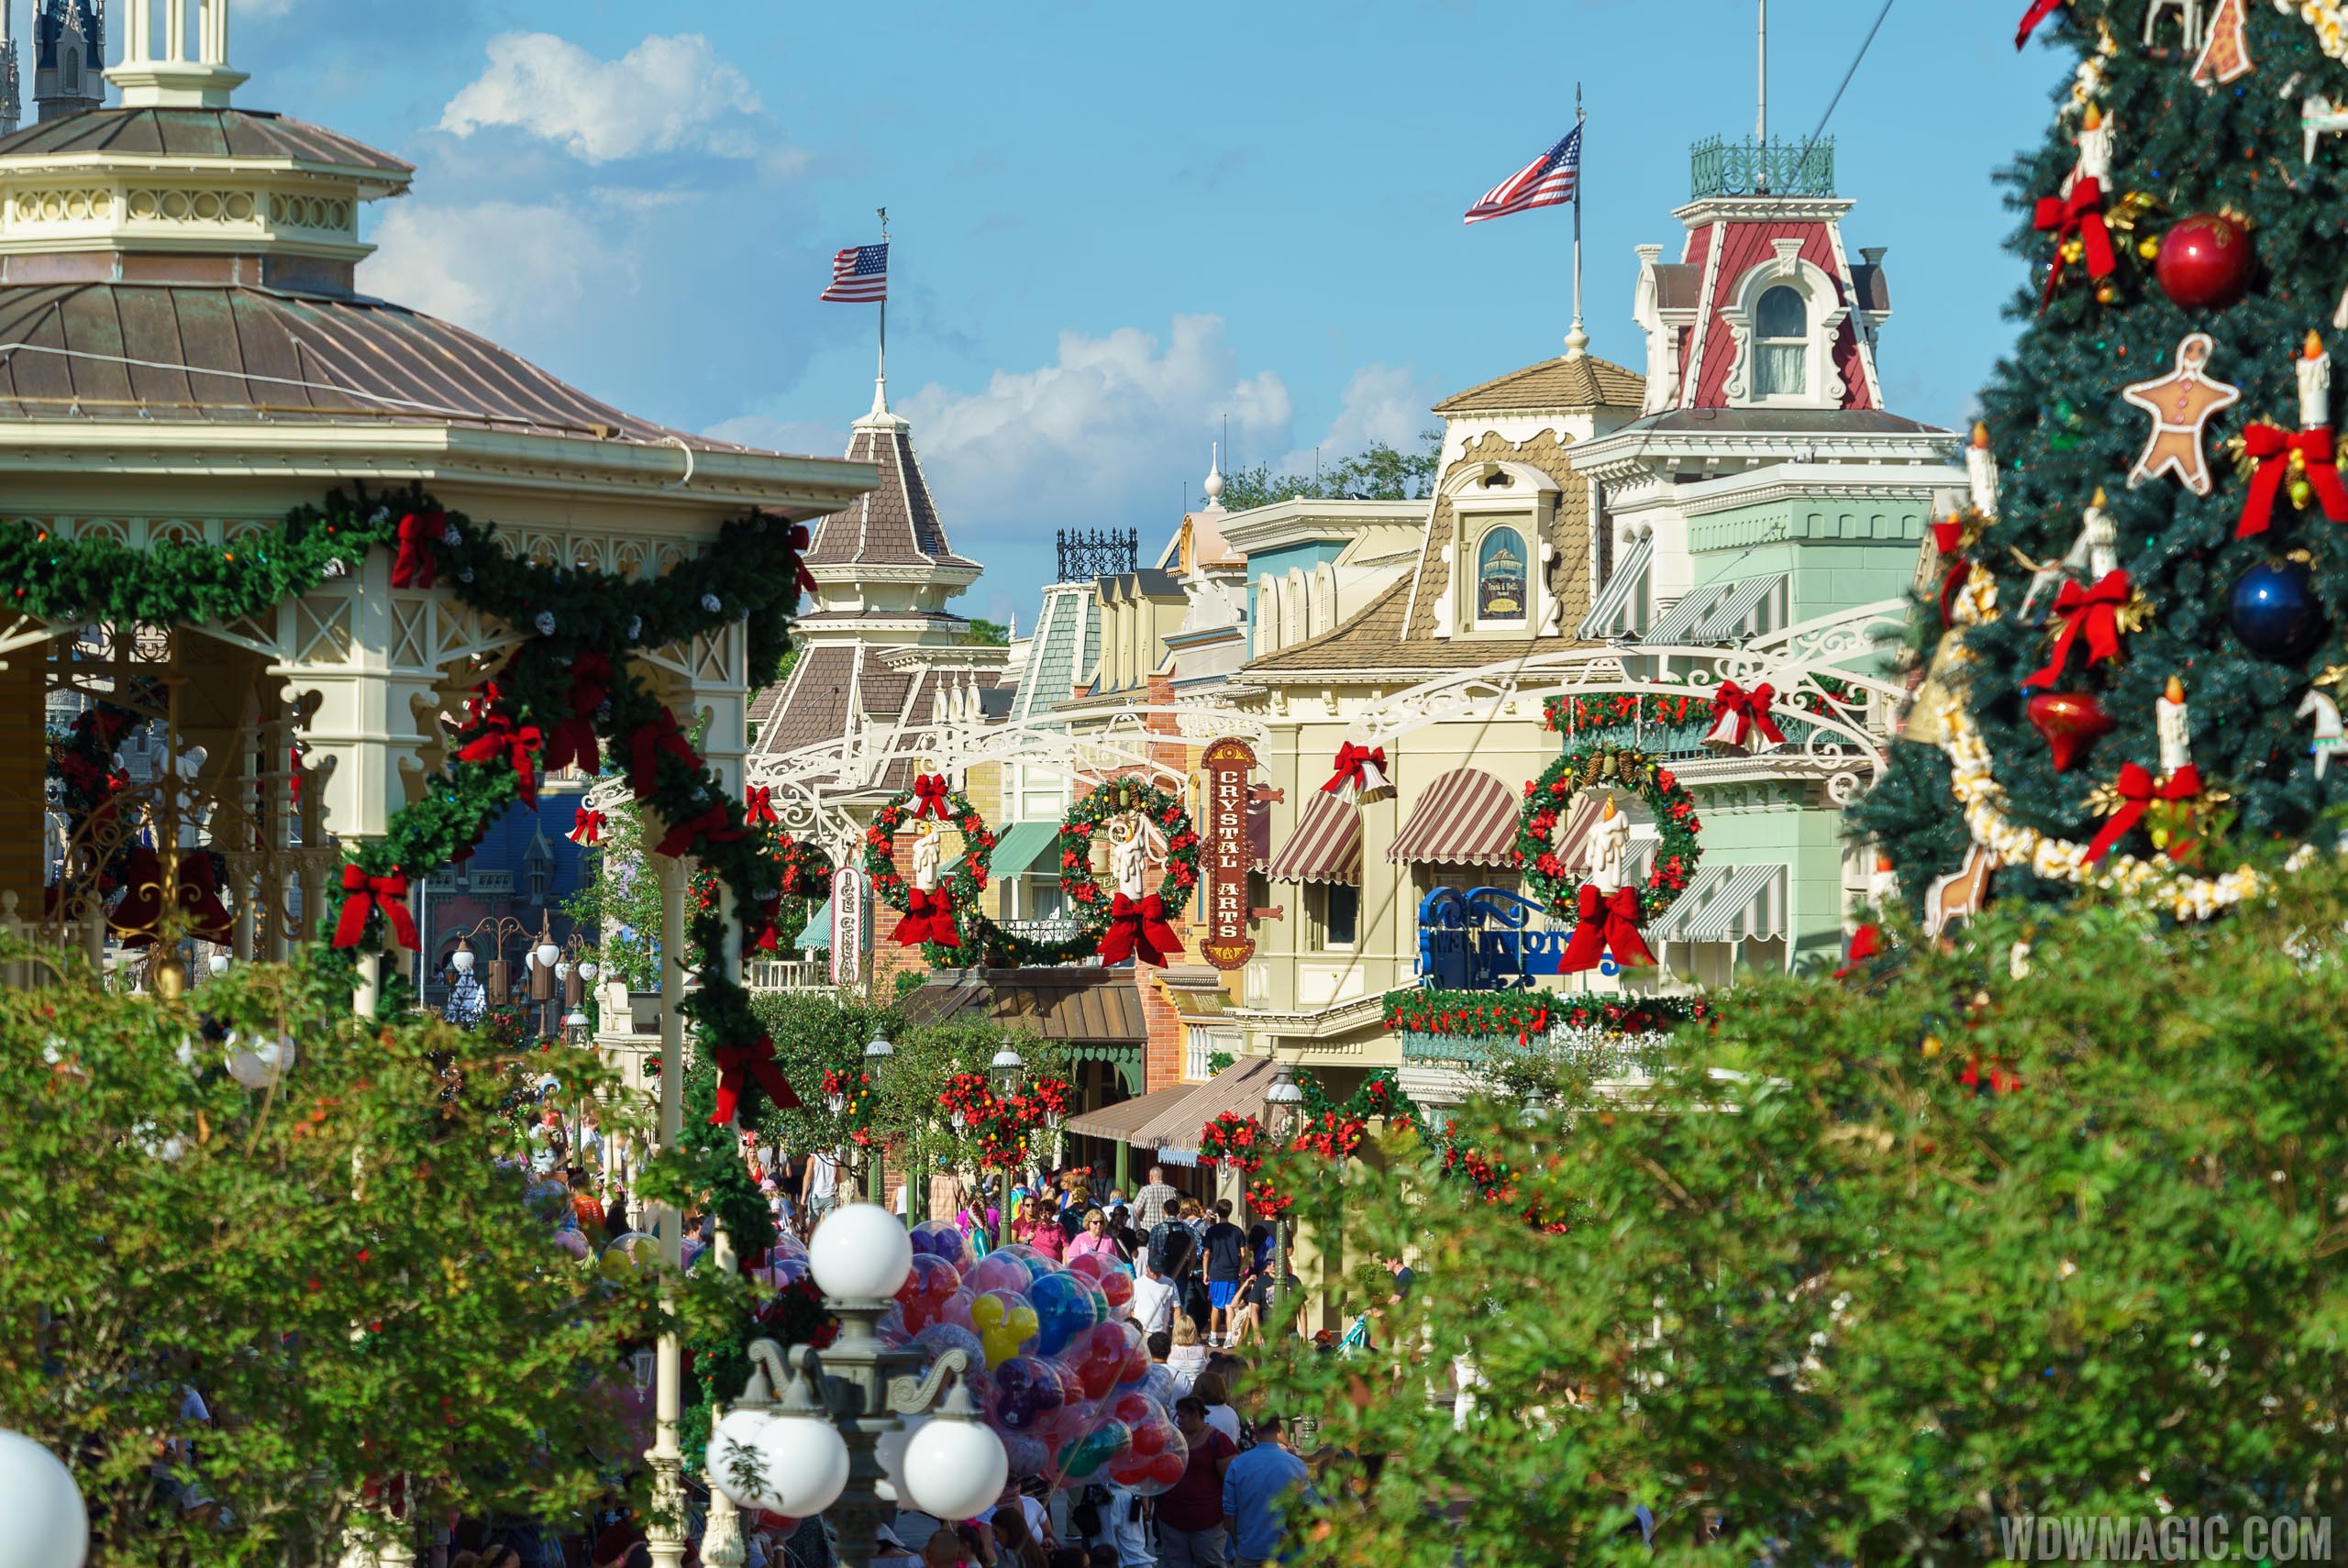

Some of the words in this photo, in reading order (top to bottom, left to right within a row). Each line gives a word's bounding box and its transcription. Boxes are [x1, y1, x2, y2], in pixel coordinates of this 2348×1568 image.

[1218, 770, 1240, 868] CRYSTAL
[840, 872, 856, 913] ICE
[1218, 883, 1240, 938] ARTS
